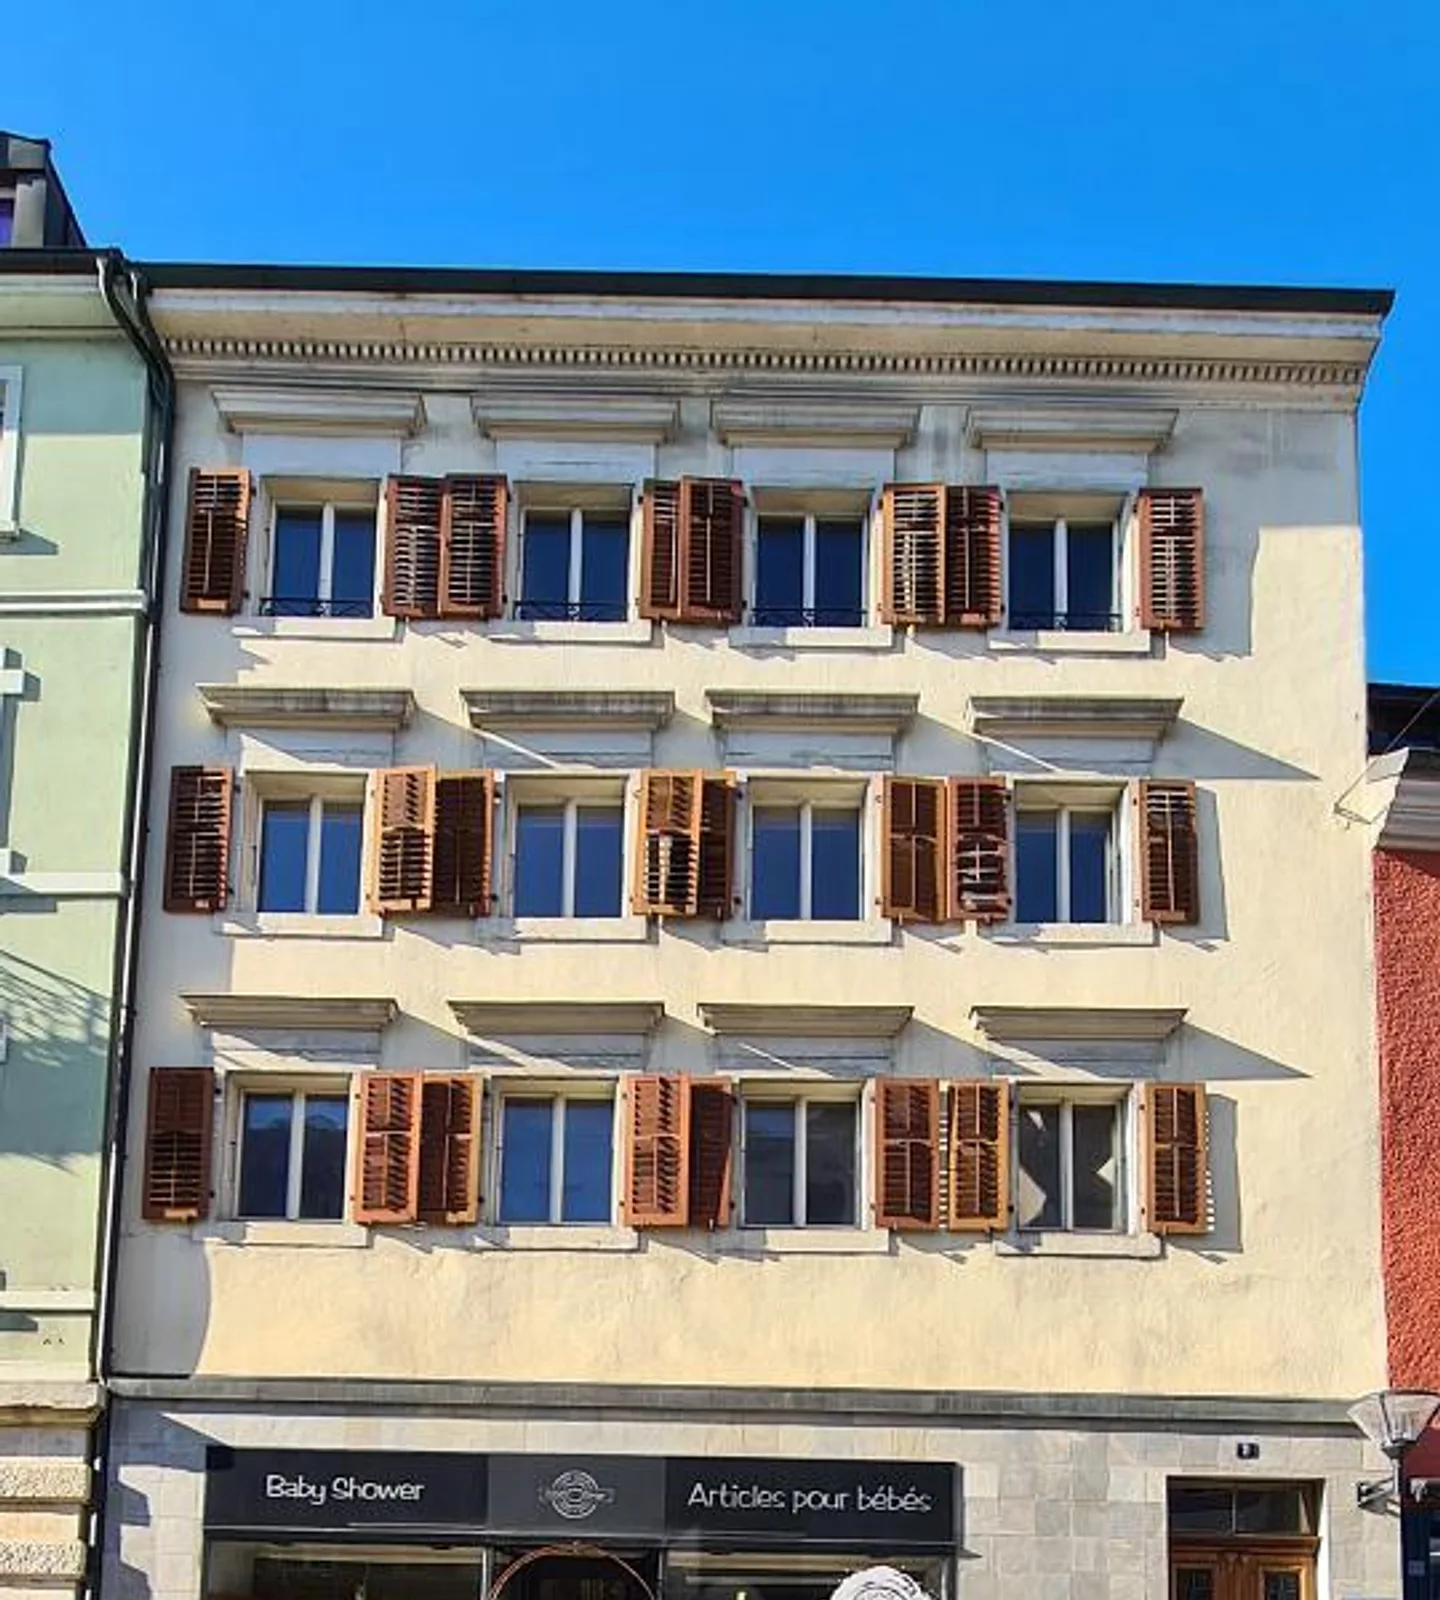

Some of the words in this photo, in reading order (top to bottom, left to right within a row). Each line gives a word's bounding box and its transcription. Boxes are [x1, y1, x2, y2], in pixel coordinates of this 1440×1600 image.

[266, 1474, 326, 1505] Baby
[332, 1476, 425, 1500] Shower
[687, 1482, 786, 1509] Articles
[792, 1489, 850, 1514] pour
[858, 1485, 932, 1512] bébés
